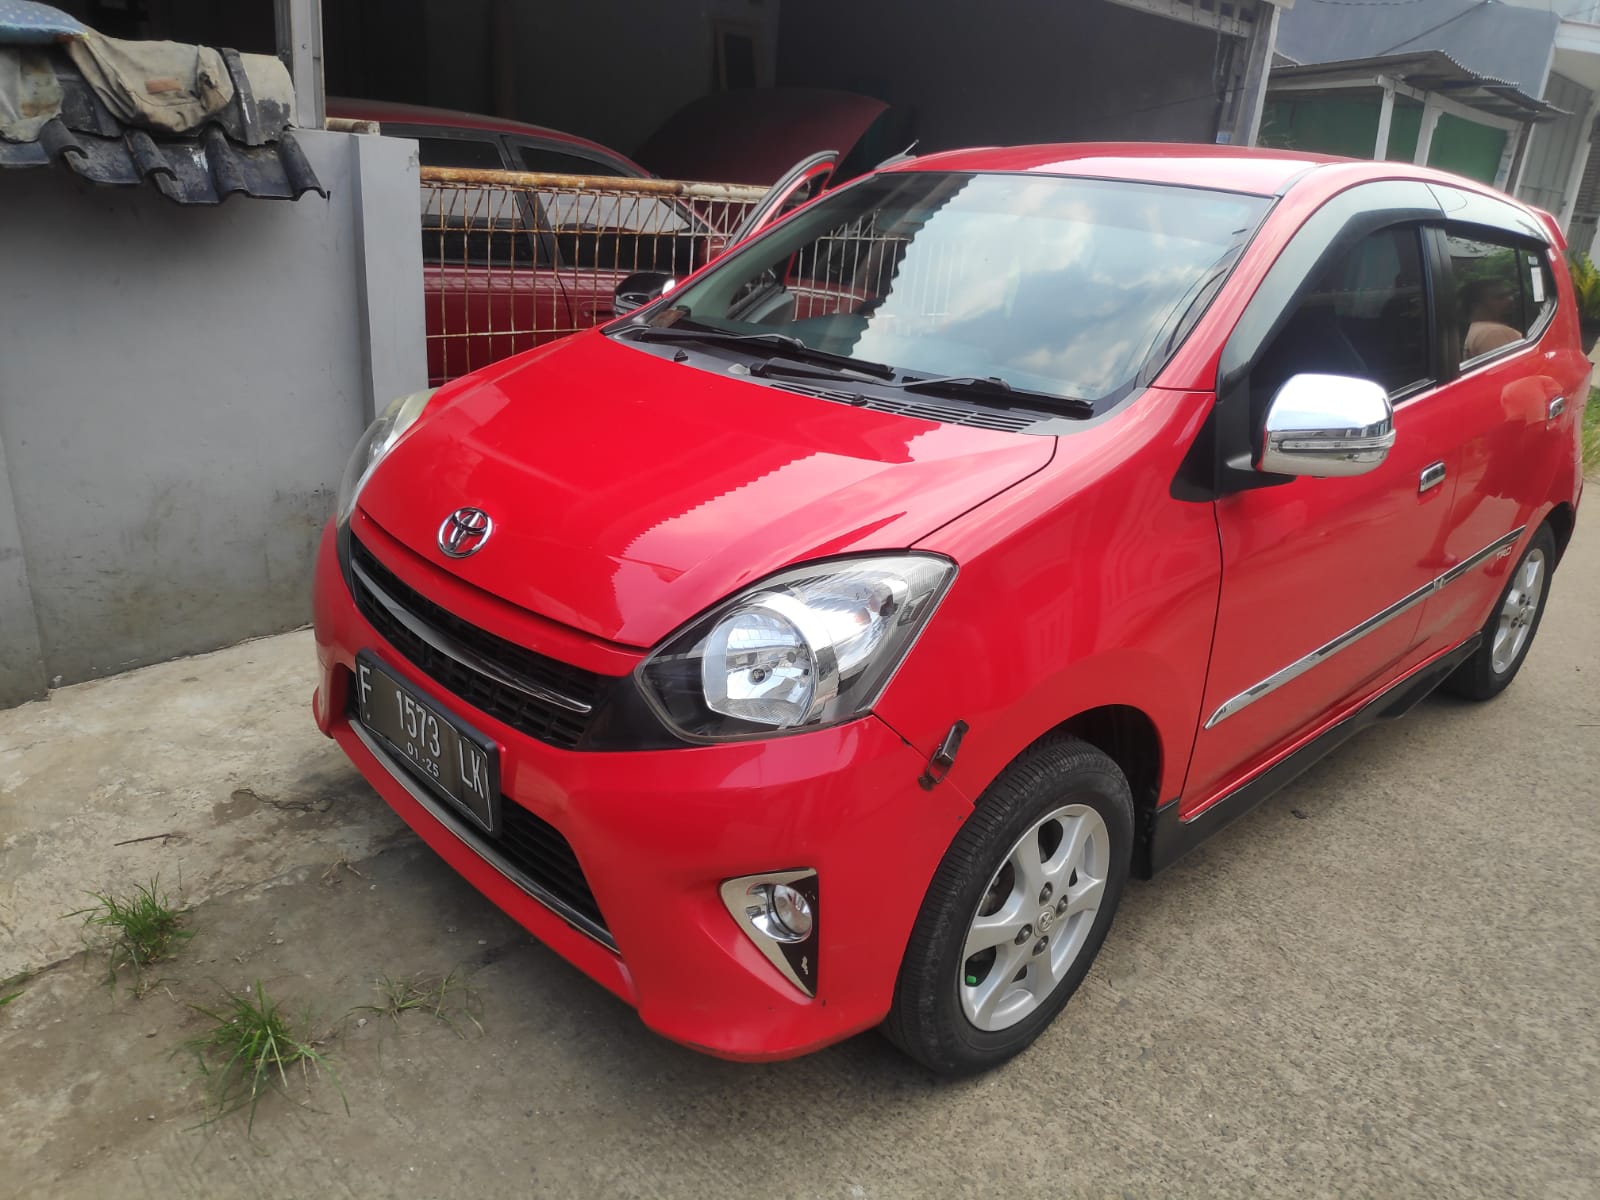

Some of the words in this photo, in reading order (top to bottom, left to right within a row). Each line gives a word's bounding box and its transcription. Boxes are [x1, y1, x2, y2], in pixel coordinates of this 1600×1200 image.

[359, 664, 372, 703] F
[396, 690, 441, 758] 1573
[458, 739, 484, 799] LK
